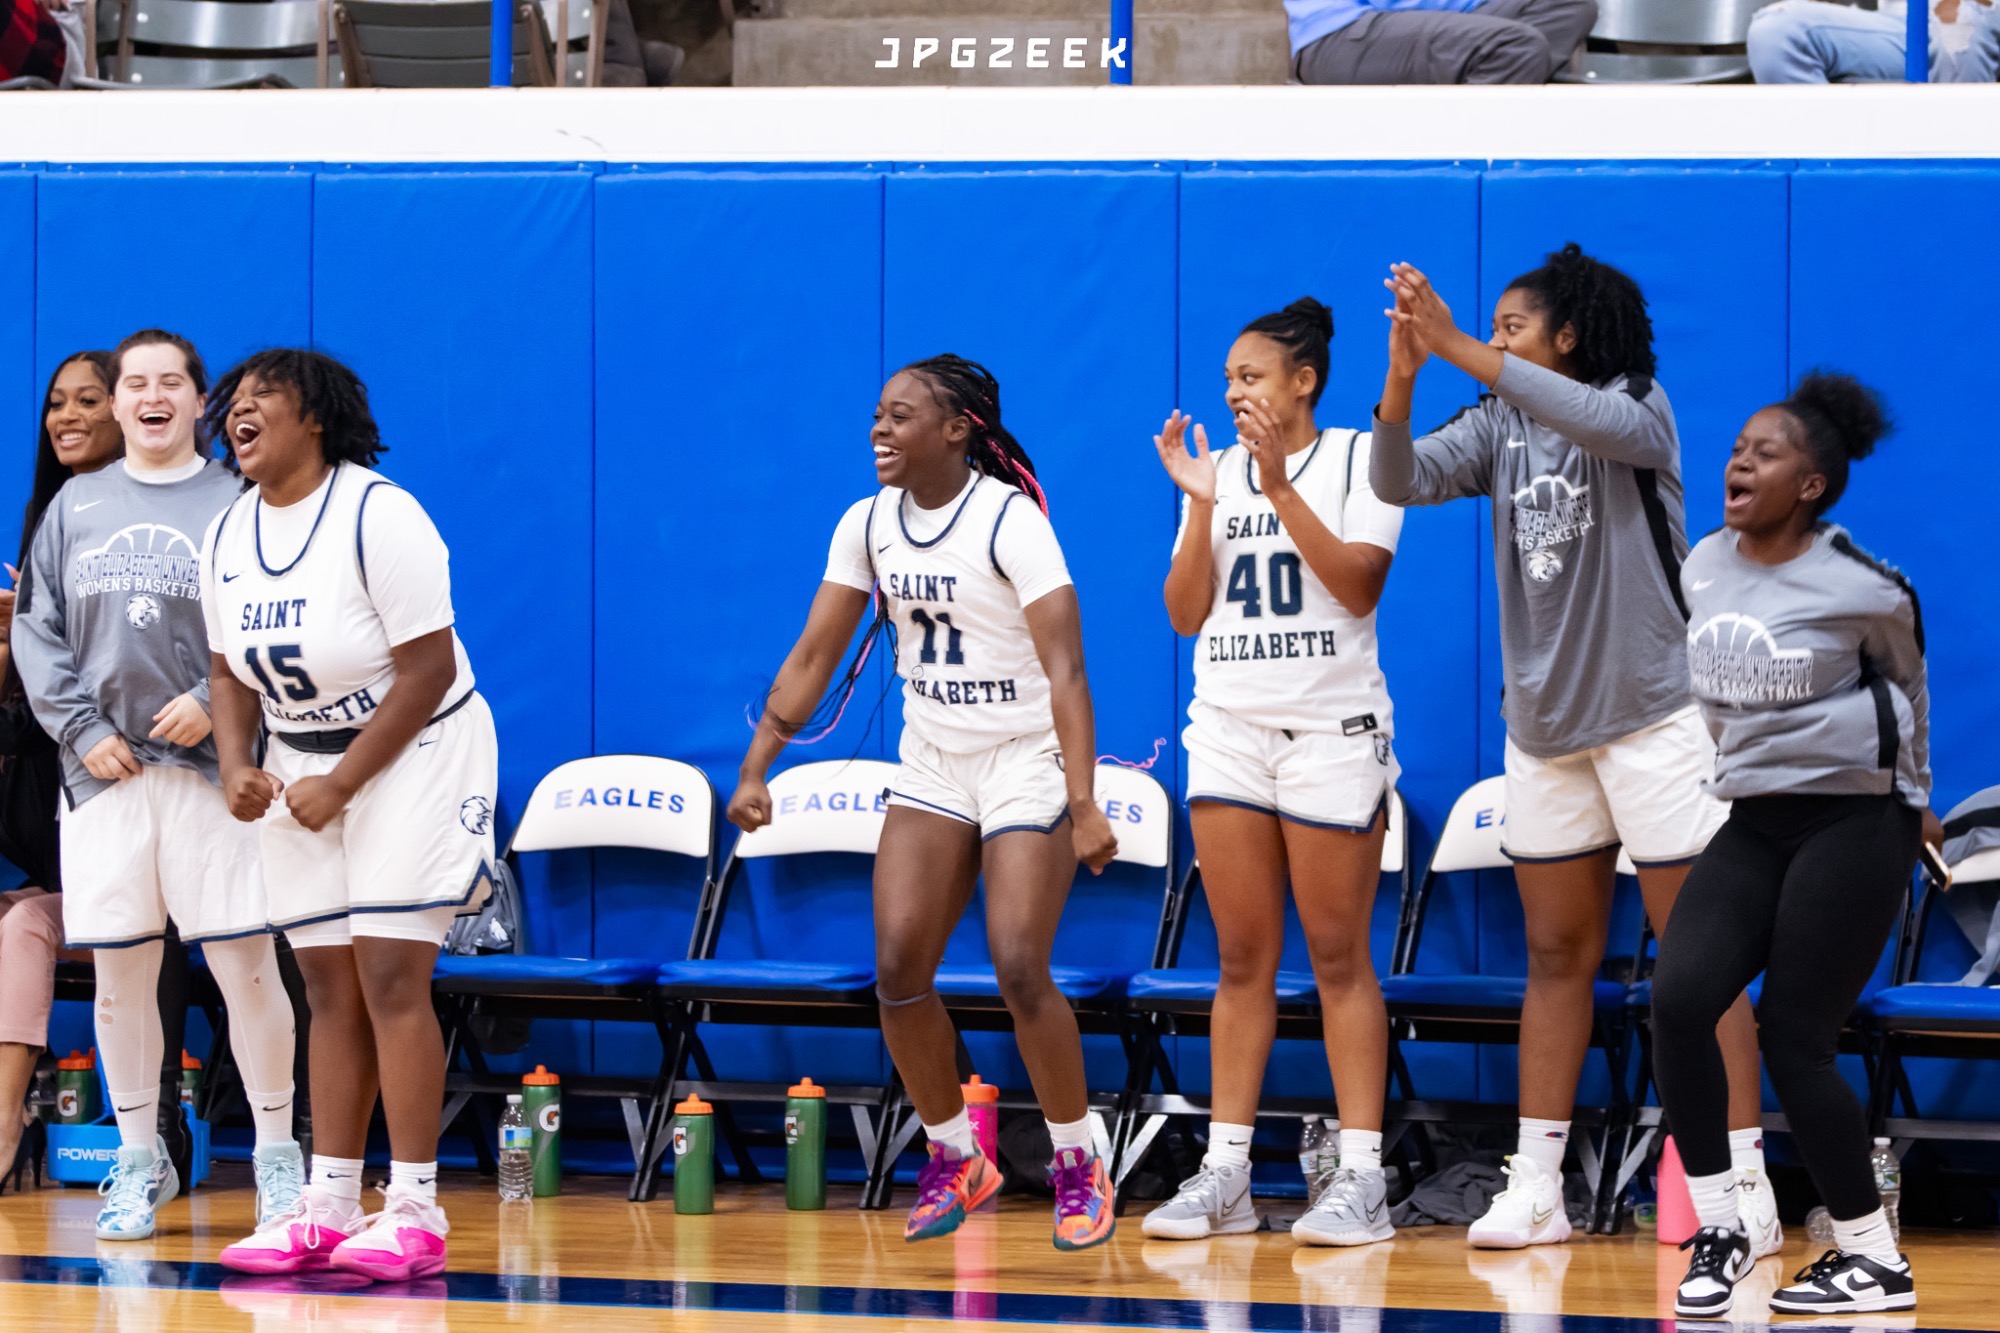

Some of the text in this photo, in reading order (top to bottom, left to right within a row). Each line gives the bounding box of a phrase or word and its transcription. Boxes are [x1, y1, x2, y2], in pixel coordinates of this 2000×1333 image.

[1226, 512, 1290, 540] SAIN
[101, 551, 162, 579] ELIZABETH
[76, 578, 131, 599] WOMEN'S
[890, 573, 957, 602] SAINT
[1225, 552, 1304, 619] 40
[241, 598, 307, 631] SAINT
[911, 608, 965, 666] 11
[1209, 630, 1336, 662] ELIZABETH
[244, 643, 319, 704] 15
[554, 787, 685, 814] EAGLES
